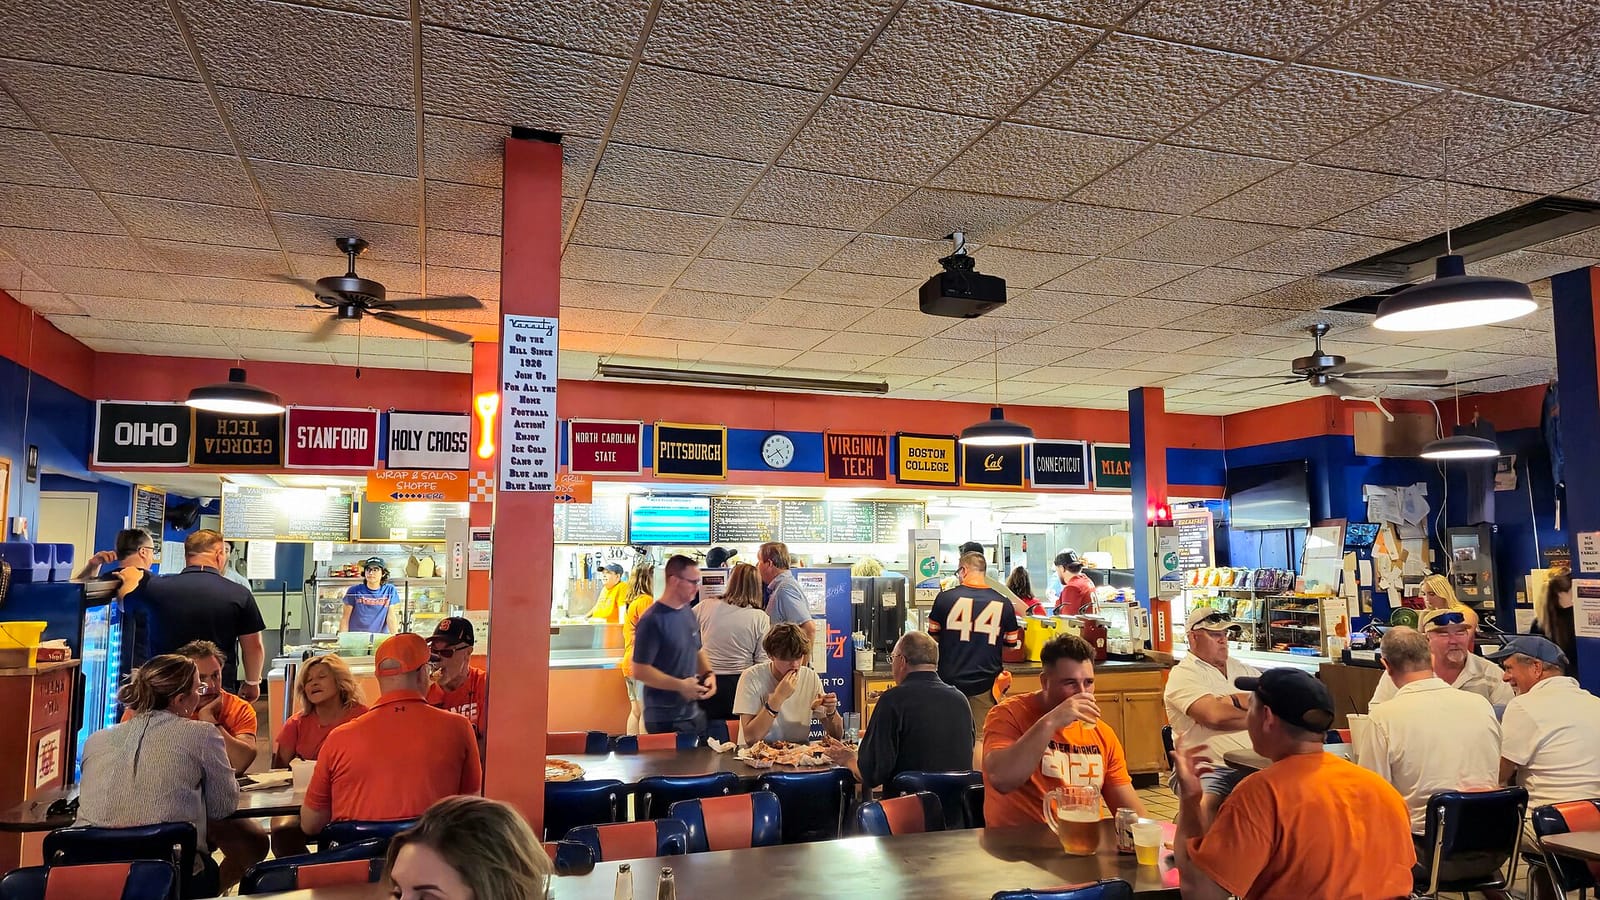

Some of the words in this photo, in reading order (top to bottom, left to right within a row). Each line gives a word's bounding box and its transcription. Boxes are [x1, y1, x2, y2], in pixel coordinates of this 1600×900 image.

[509, 345, 528, 355] HILL
[530, 347, 554, 357] SINCE
[519, 359, 542, 368] 1926
[514, 371, 533, 380] JOIN
[535, 371, 547, 380] US
[504, 382, 520, 392] FOR
[522, 383, 539, 392] ALL
[519, 395, 541, 405] HOME
[510, 407, 549, 417] FOOTBALL
[217, 418, 260, 437] TECH
[513, 420, 546, 429] ACTION!
[297, 426, 369, 450] STANFORD
[391, 429, 424, 452] HOLY
[427, 431, 468, 453] CROSS
[515, 432, 540, 441] ENJOY
[575, 432, 599, 444] NORTH
[601, 432, 637, 445] CAROLINA
[204, 437, 273, 455] GEORGIA
[511, 444, 525, 453] ICE
[527, 444, 547, 454] COLD
[829, 435, 885, 457] VIRGINIA
[594, 451, 617, 463] STATE
[659, 441, 722, 463] PITTSBURGH
[908, 447, 946, 460] BOSTON
[511, 456, 532, 466] CANS
[534, 458, 544, 466] OF
[905, 460, 950, 473] COLLEGE
[983, 452, 1004, 472] Cal
[1036, 455, 1081, 474] CONNECTICUT
[842, 457, 876, 478] TECH
[1101, 459, 1131, 475] MIAM
[376, 471, 409, 480] WRAP
[411, 471, 418, 480] &
[420, 472, 458, 481] SALAD
[509, 469, 531, 478] BLUE
[532, 470, 548, 479] AND
[561, 474, 585, 483] GRILL
[395, 481, 438, 491] SHOPPE
[505, 481, 526, 490] BLUE
[528, 482, 552, 491] LIGHT
[555, 484, 575, 492] ODS
[946, 597, 1004, 646] 44
[831, 677, 845, 687] TO
